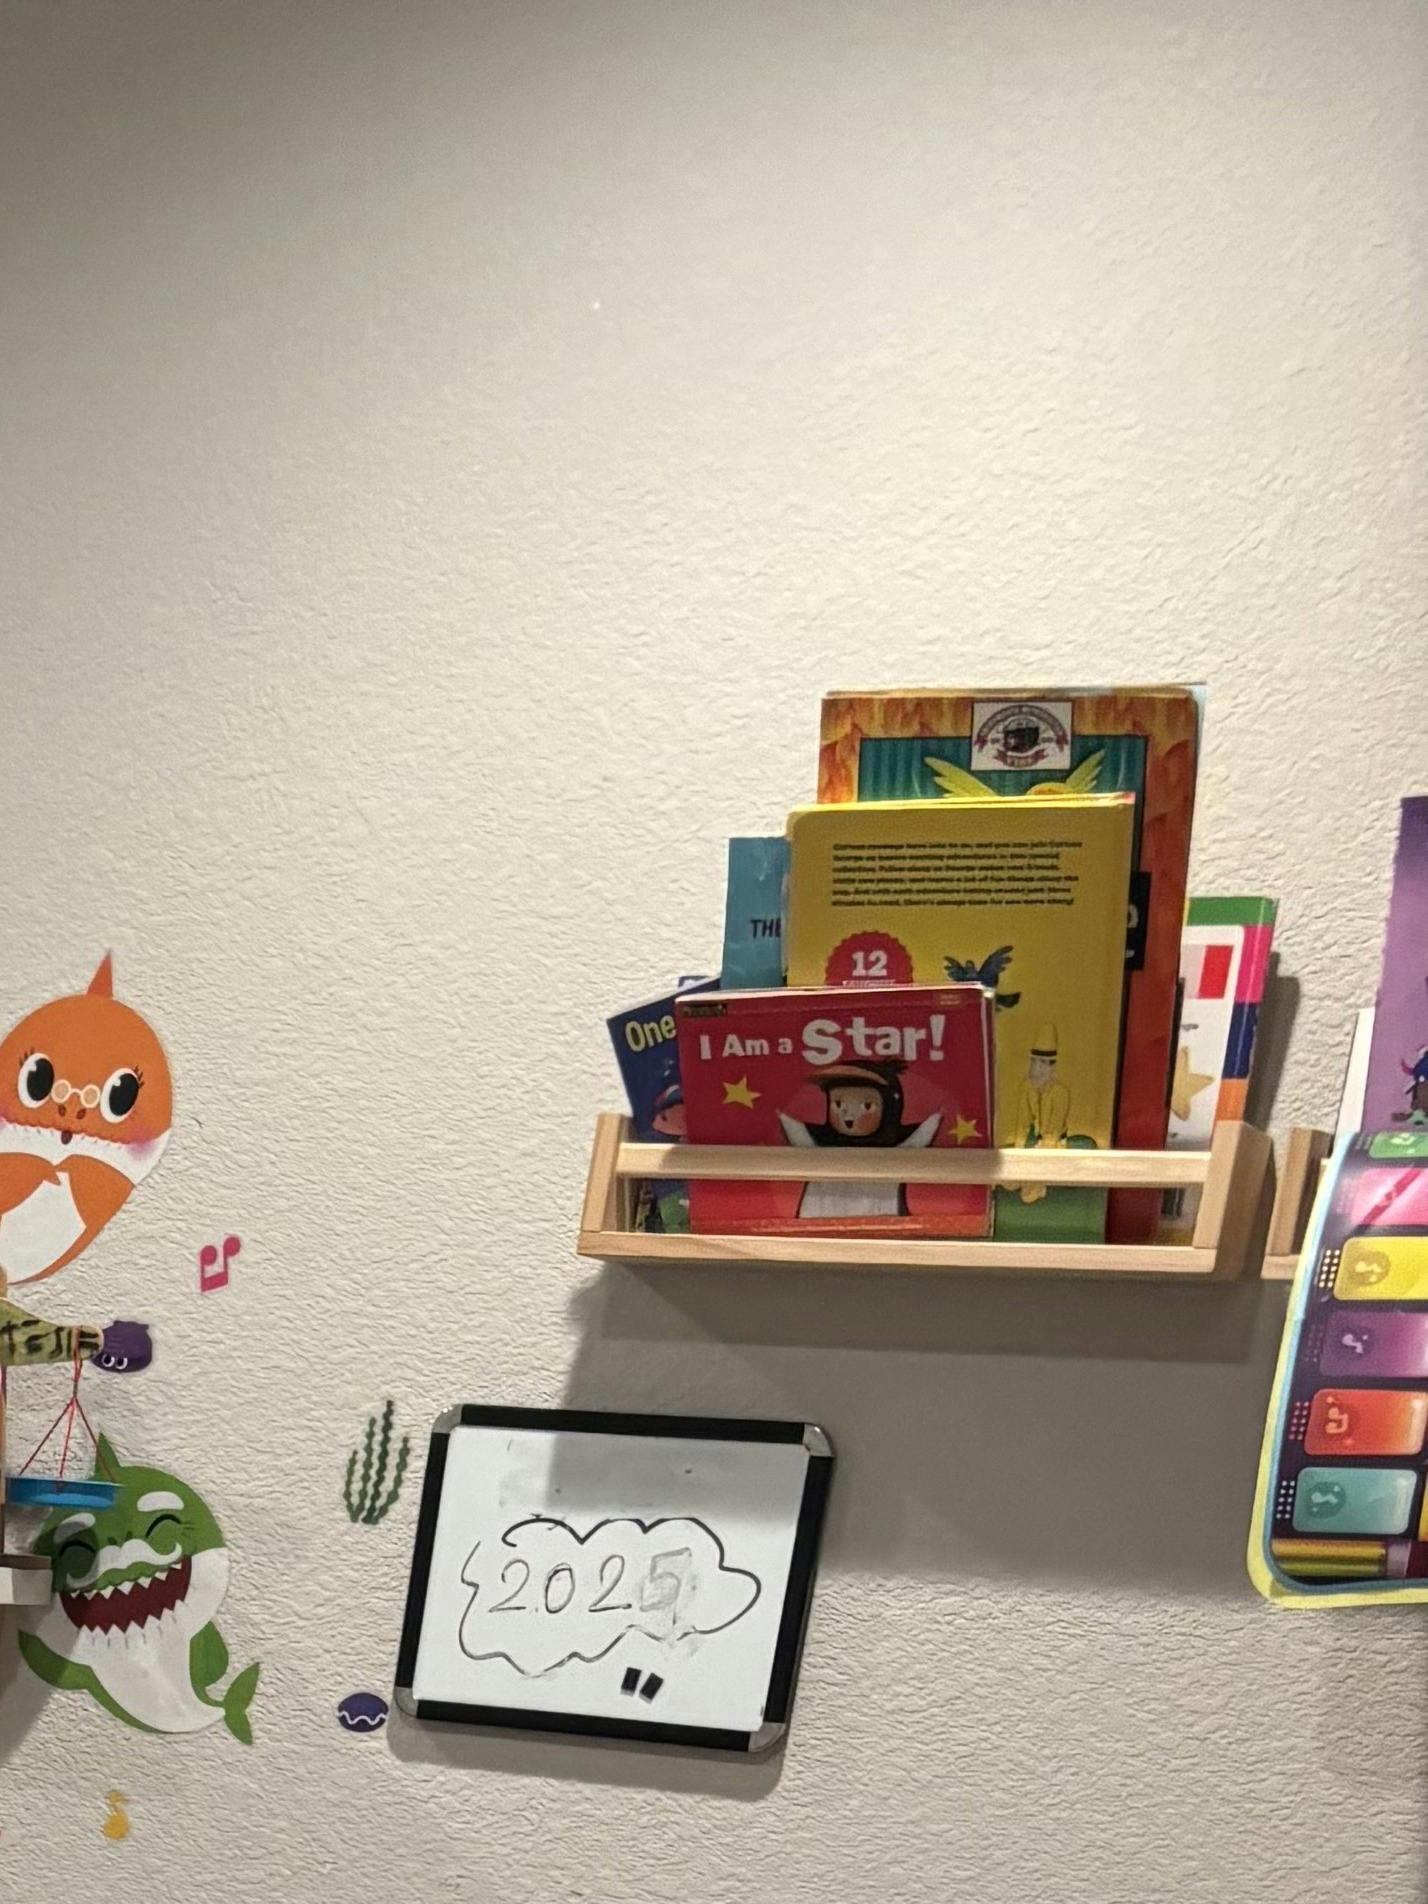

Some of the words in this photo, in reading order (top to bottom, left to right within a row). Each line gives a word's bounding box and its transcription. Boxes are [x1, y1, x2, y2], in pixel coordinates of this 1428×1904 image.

[852, 950, 888, 977] 12
[624, 1015, 676, 1052] One
[699, 1034, 712, 1060] I
[722, 1033, 769, 1057] Am
[777, 1036, 793, 1054] a
[801, 1015, 946, 1065] Star!
